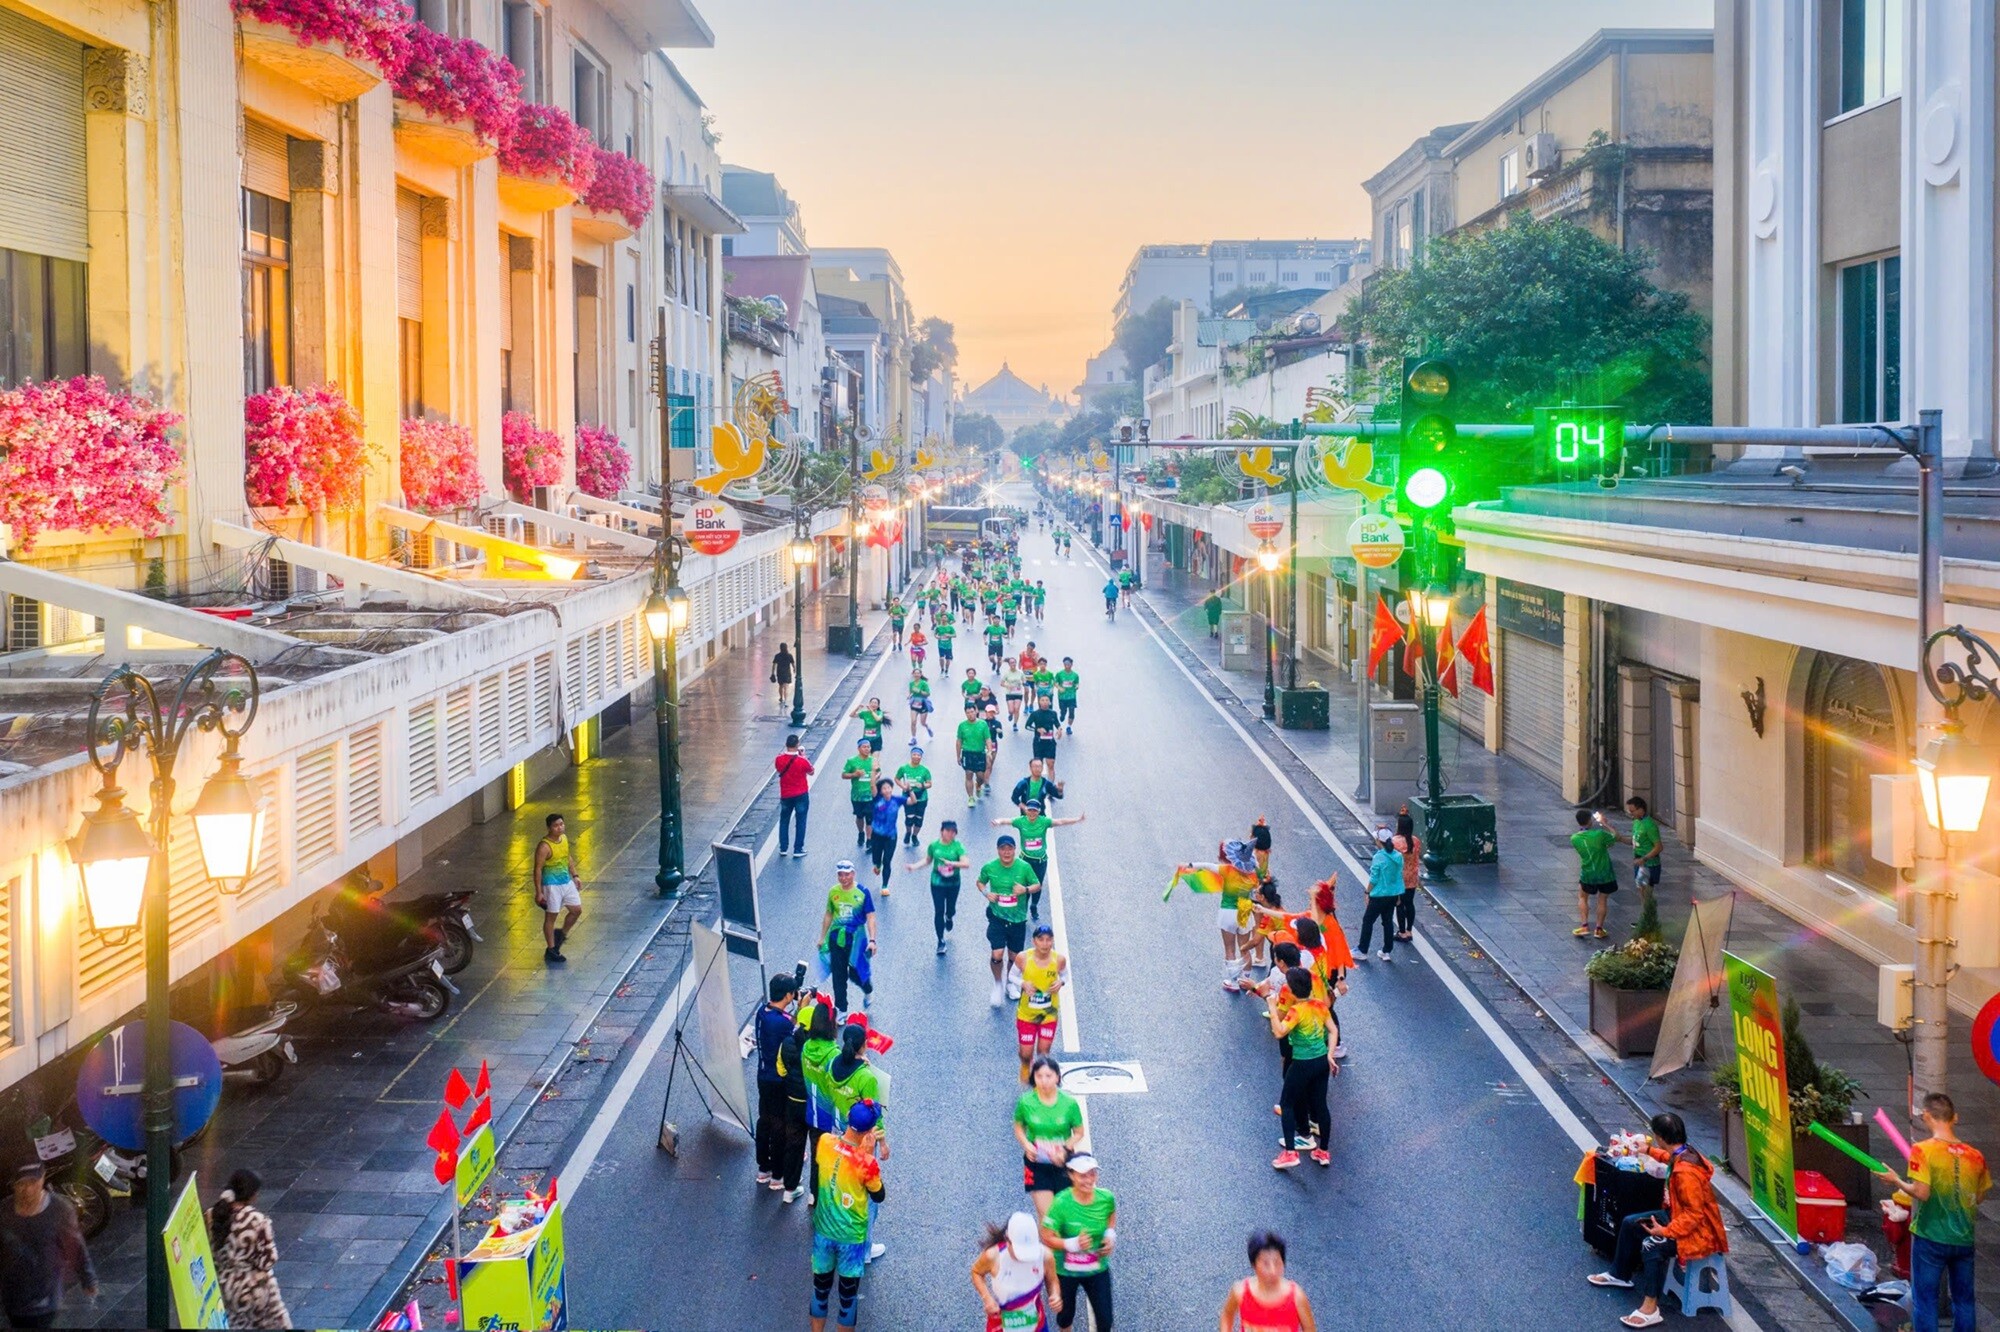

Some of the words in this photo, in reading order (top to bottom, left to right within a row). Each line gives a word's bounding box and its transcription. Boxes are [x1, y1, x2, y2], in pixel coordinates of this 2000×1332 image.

[1555, 422, 1605, 462] 04
[695, 508, 713, 518] HD
[696, 519, 726, 529] Bank
[1360, 523, 1378, 533] HD
[1361, 533, 1390, 542] Bank
[1734, 1011, 1778, 1070] LONG
[1739, 1053, 1782, 1121] RUN
